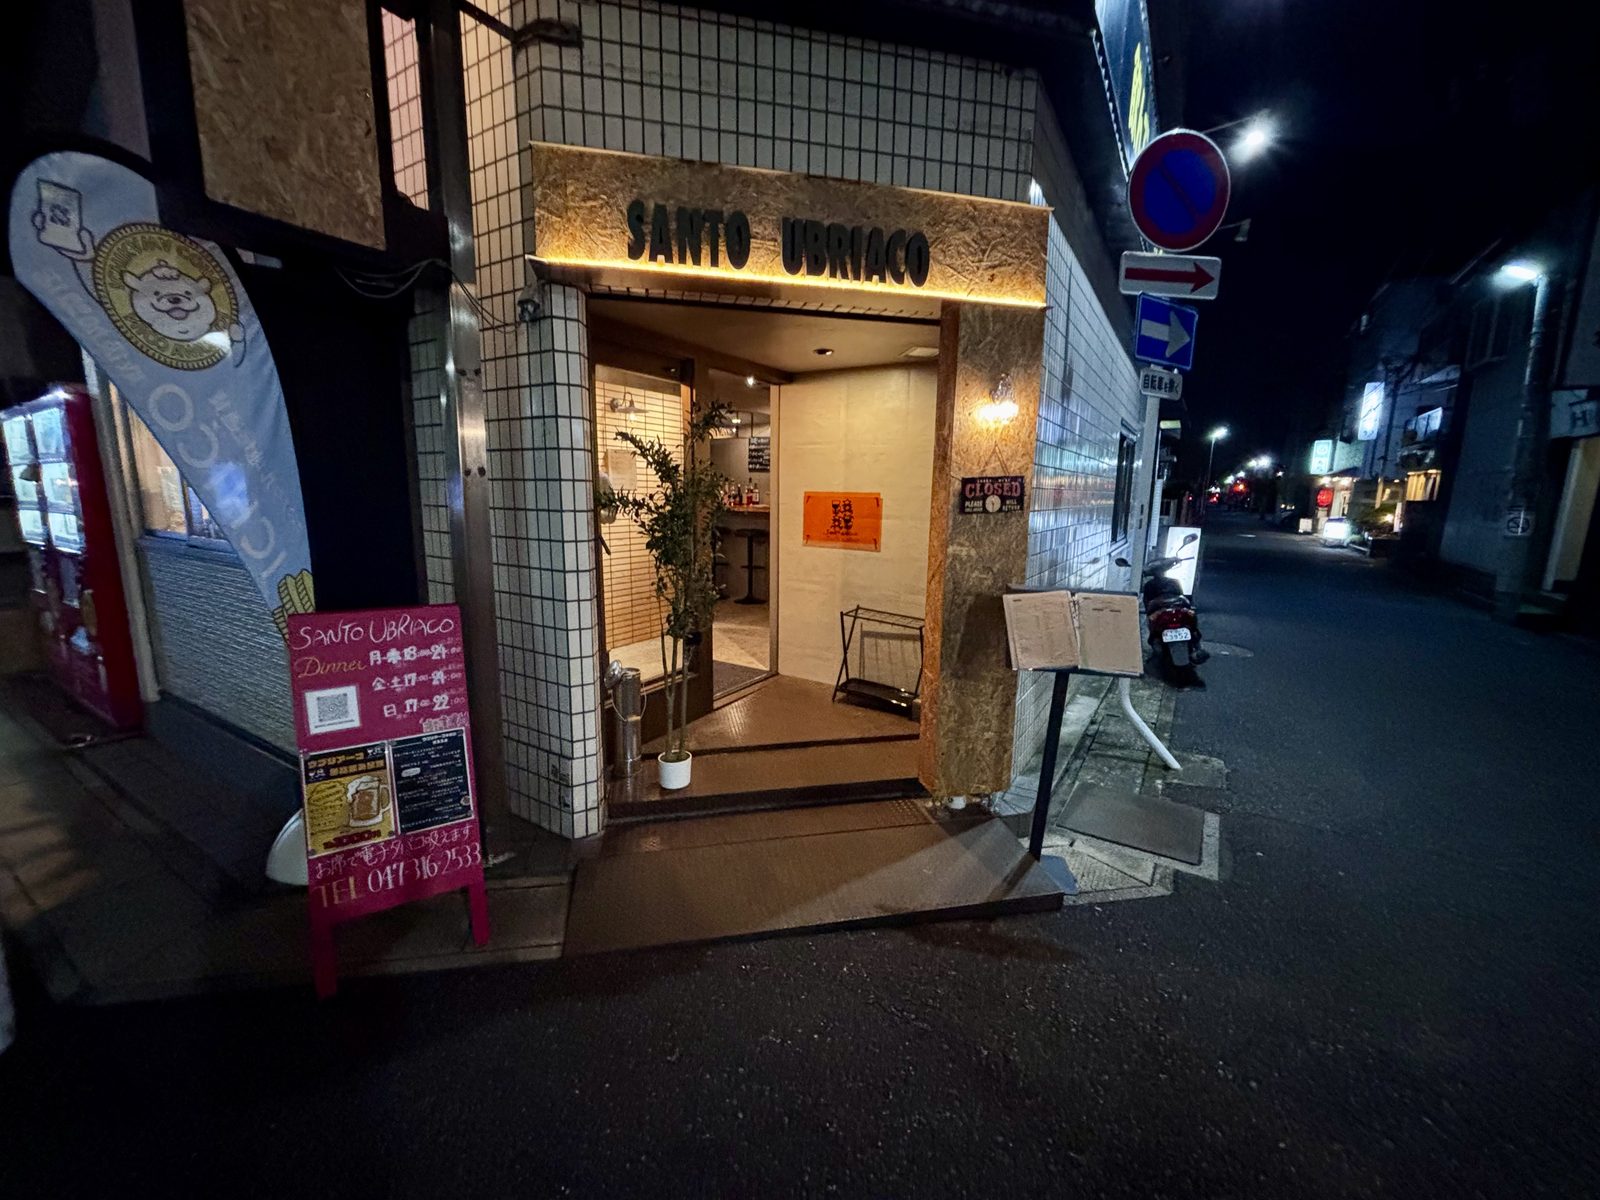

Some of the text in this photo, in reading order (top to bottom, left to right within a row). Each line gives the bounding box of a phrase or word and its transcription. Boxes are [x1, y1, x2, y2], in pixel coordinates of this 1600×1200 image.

[626, 199, 930, 288] SANTO UBRIACO
[1143, 373, 1180, 396] 自転車を除く
[964, 481, 1021, 498] CLOSED
[293, 613, 454, 650] SANTO UBRIACO
[294, 656, 366, 679] Dinner
[313, 874, 364, 908] TEL
